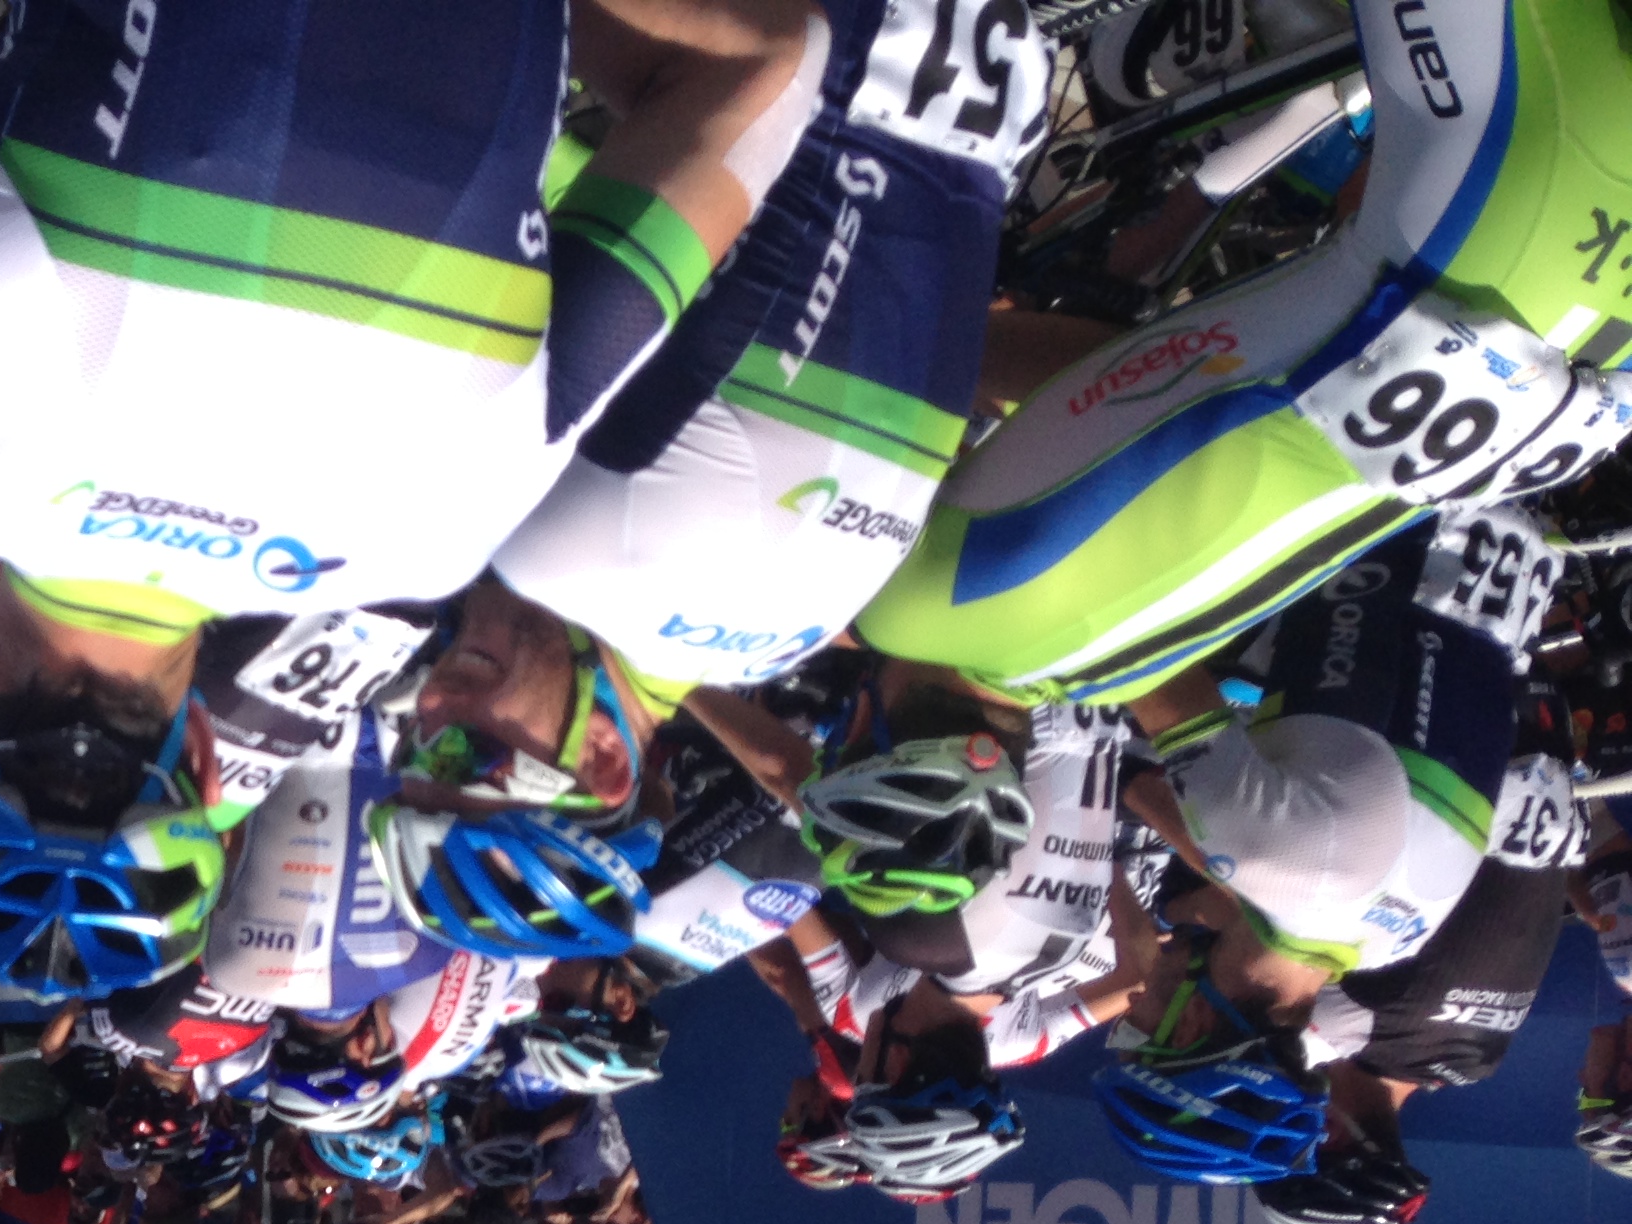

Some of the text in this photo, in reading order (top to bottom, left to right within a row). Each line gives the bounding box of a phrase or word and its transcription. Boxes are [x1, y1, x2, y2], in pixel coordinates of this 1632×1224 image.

[902, 0, 1028, 140] 51
[777, 198, 861, 388] SCOTT
[1068, 320, 1239, 417] Sojasun
[1342, 369, 1500, 487] 66
[78, 513, 244, 560] ORICA
[87, 490, 260, 537] GreenEDGE
[1452, 519, 1524, 620] 55
[272, 642, 360, 709] 76
[525, 809, 643, 897] SCOTT
[1501, 796, 1558, 857] 37
[1006, 874, 1102, 909] GIANT
[238, 927, 295, 951] UHC
[433, 951, 470, 1032] SHARP
[1427, 1003, 1531, 1032] REK
[1120, 1064, 1219, 1118] SCOTT
